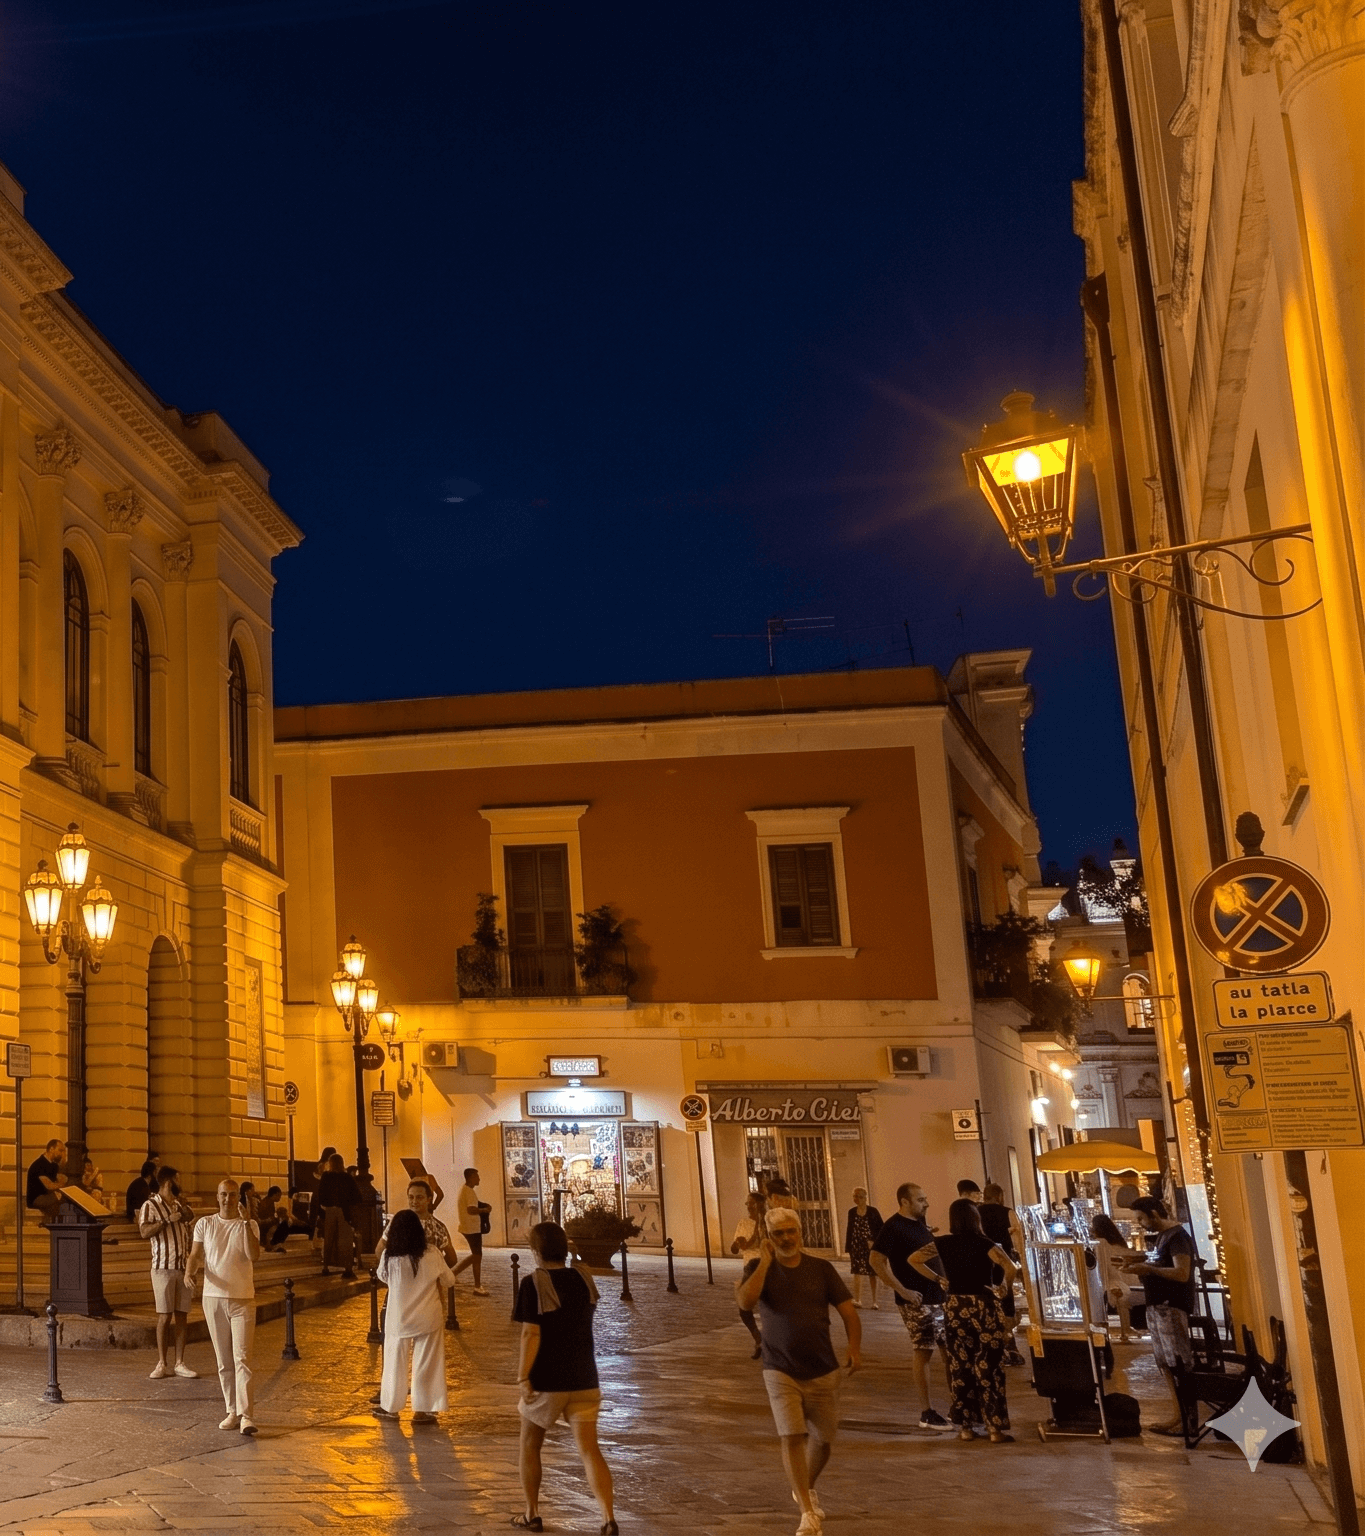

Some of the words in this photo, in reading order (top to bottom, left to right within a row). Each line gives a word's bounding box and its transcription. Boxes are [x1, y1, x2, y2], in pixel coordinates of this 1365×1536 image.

[1230, 988, 1252, 999] au
[1260, 982, 1311, 997] tatla
[1230, 1006, 1248, 1019] la
[711, 1097, 806, 1121] Alberto
